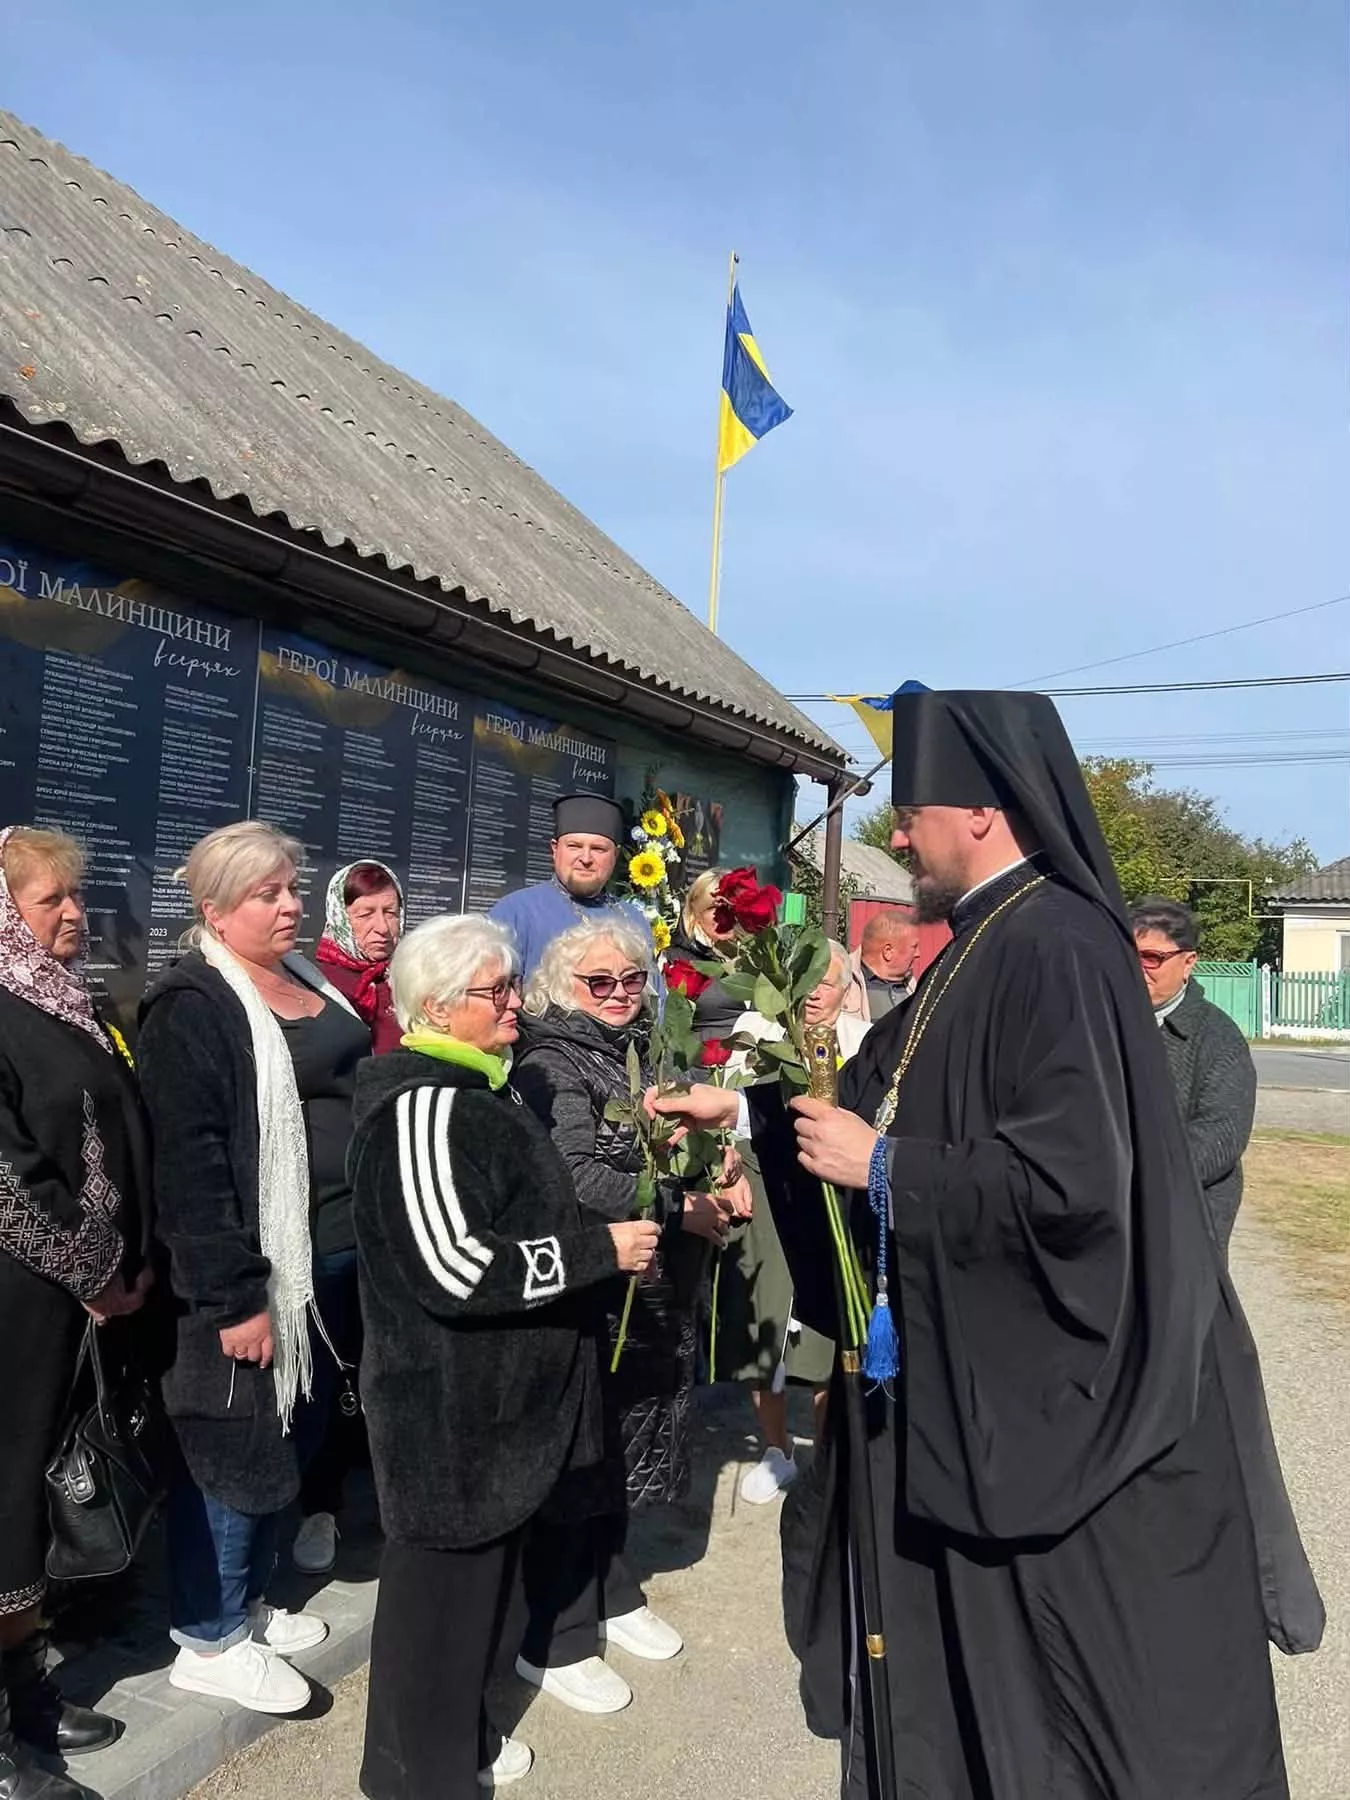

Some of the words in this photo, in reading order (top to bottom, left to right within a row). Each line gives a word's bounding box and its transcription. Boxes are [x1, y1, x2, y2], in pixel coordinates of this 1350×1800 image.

[38, 571, 232, 652] МАЛИНЩИНИ
[277, 646, 338, 684] ГЕРОЇ
[343, 667, 459, 721] МАЛИНЩИНИ
[486, 713, 525, 741] ГЕРОЇ
[528, 726, 606, 765] МАЛИНЩИНИ
[149, 927, 168, 937] 2023
